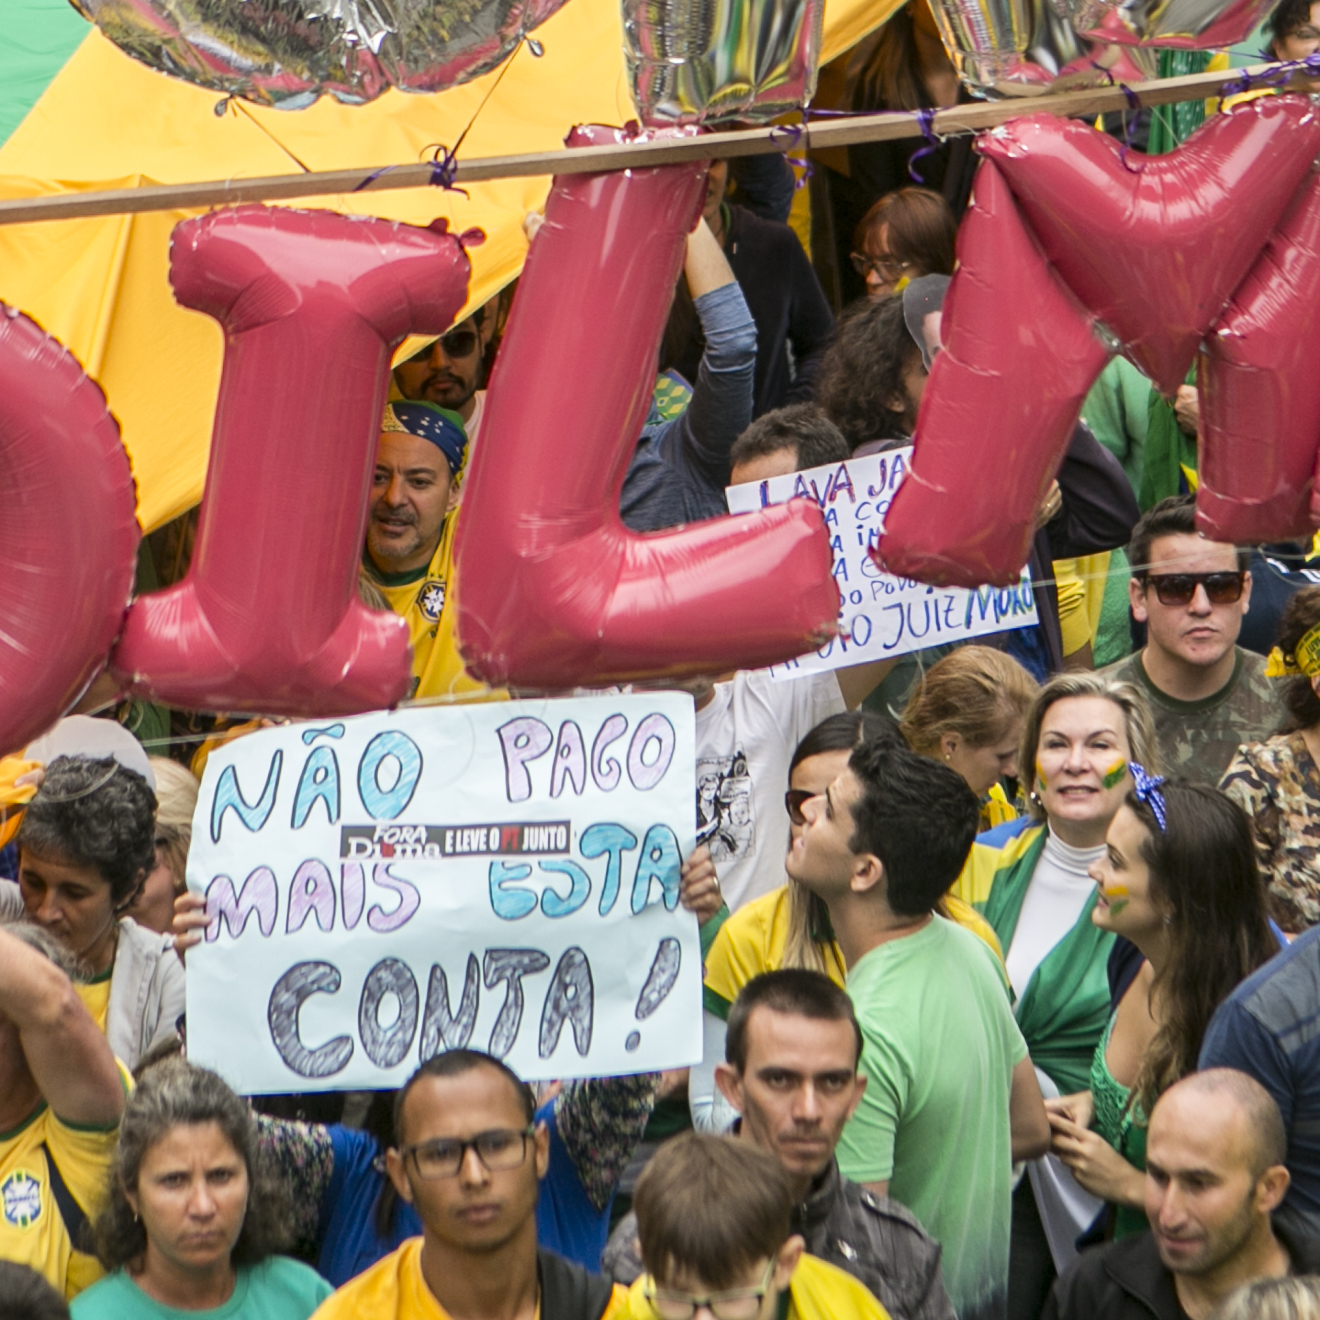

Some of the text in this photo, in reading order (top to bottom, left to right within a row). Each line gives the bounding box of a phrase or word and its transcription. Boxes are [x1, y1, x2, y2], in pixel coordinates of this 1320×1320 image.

[210, 712, 677, 844] NÃO PAGO
[373, 824, 427, 846] FORA
[445, 825, 567, 853] E LEVE O PT JUNTO
[204, 822, 682, 942] MAIS ESTA
